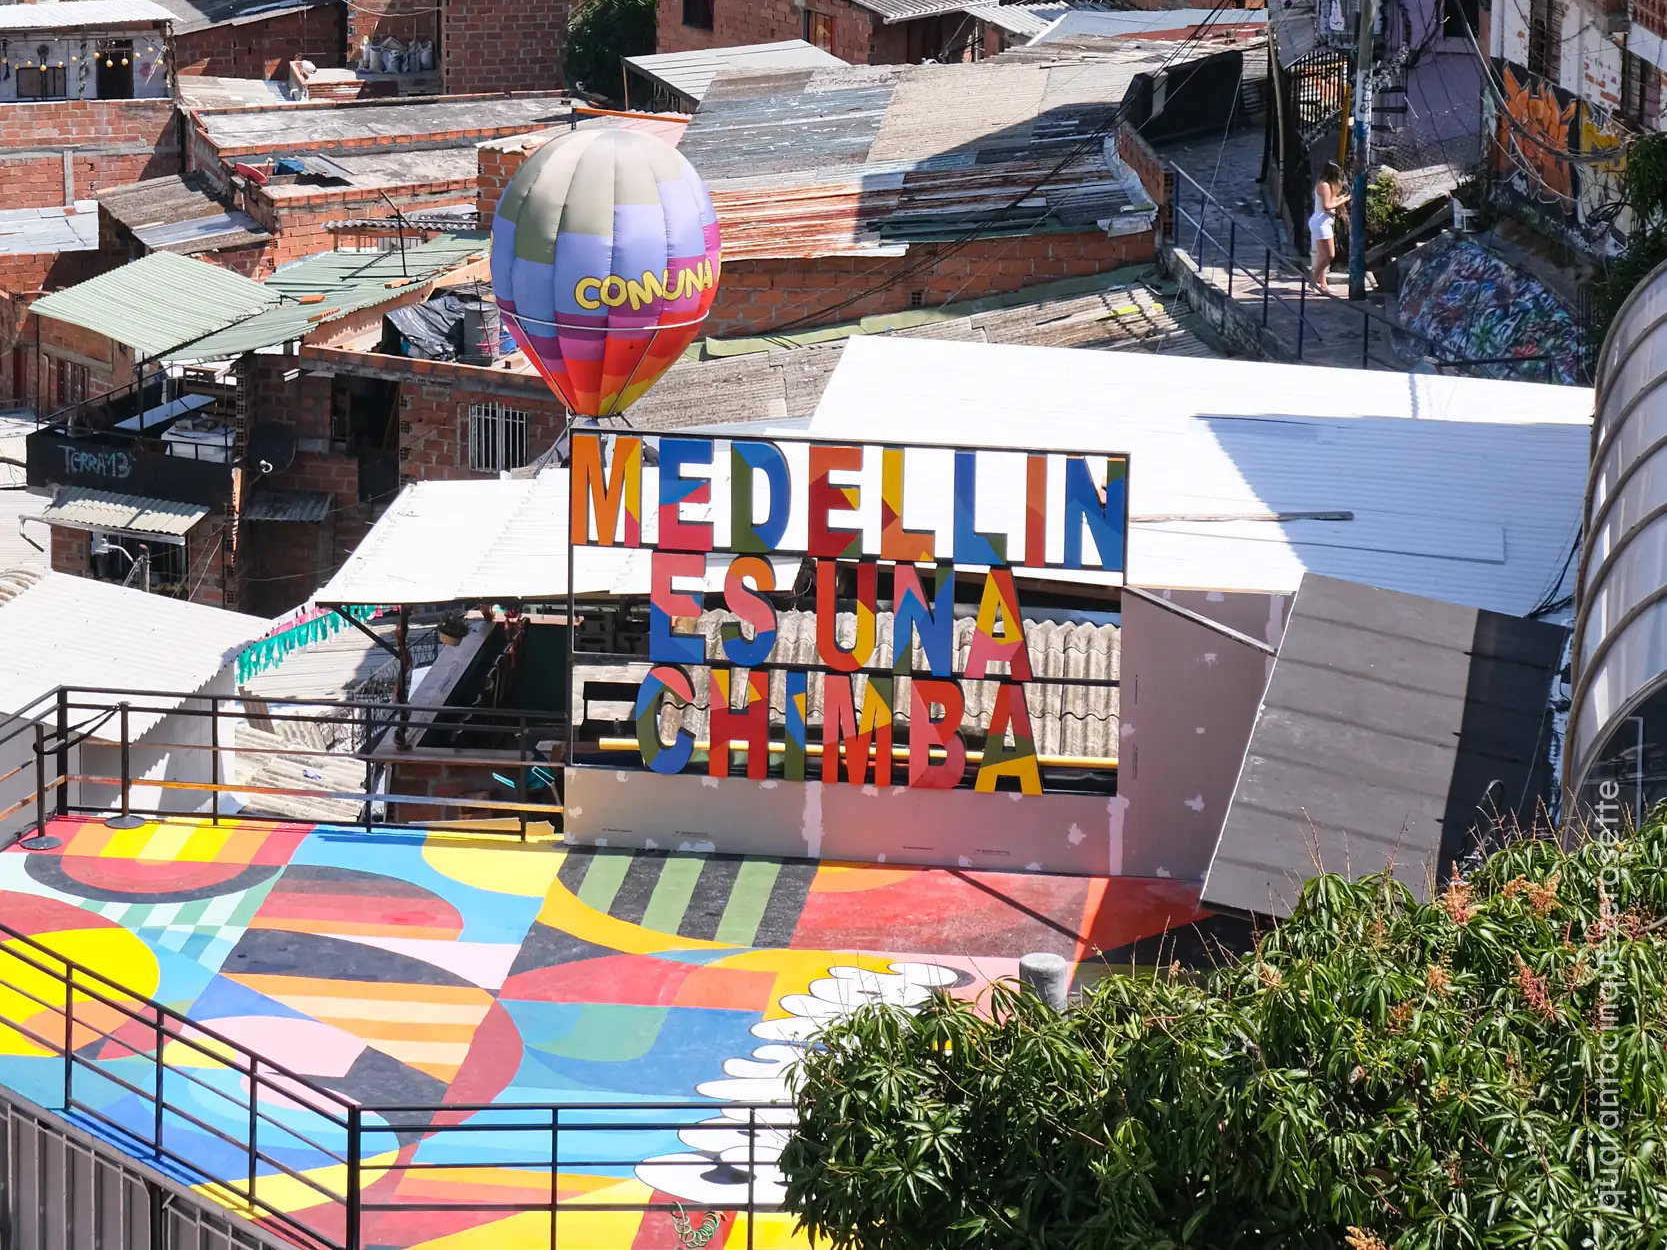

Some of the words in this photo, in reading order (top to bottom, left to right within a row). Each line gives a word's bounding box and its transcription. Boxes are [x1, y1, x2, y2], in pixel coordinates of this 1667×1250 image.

[573, 257, 713, 311] COMUNA
[571, 434, 1128, 571] MEDELLIN
[650, 551, 777, 667] ES
[815, 557, 1033, 682] UNA
[635, 664, 1044, 796] CHIMBA
